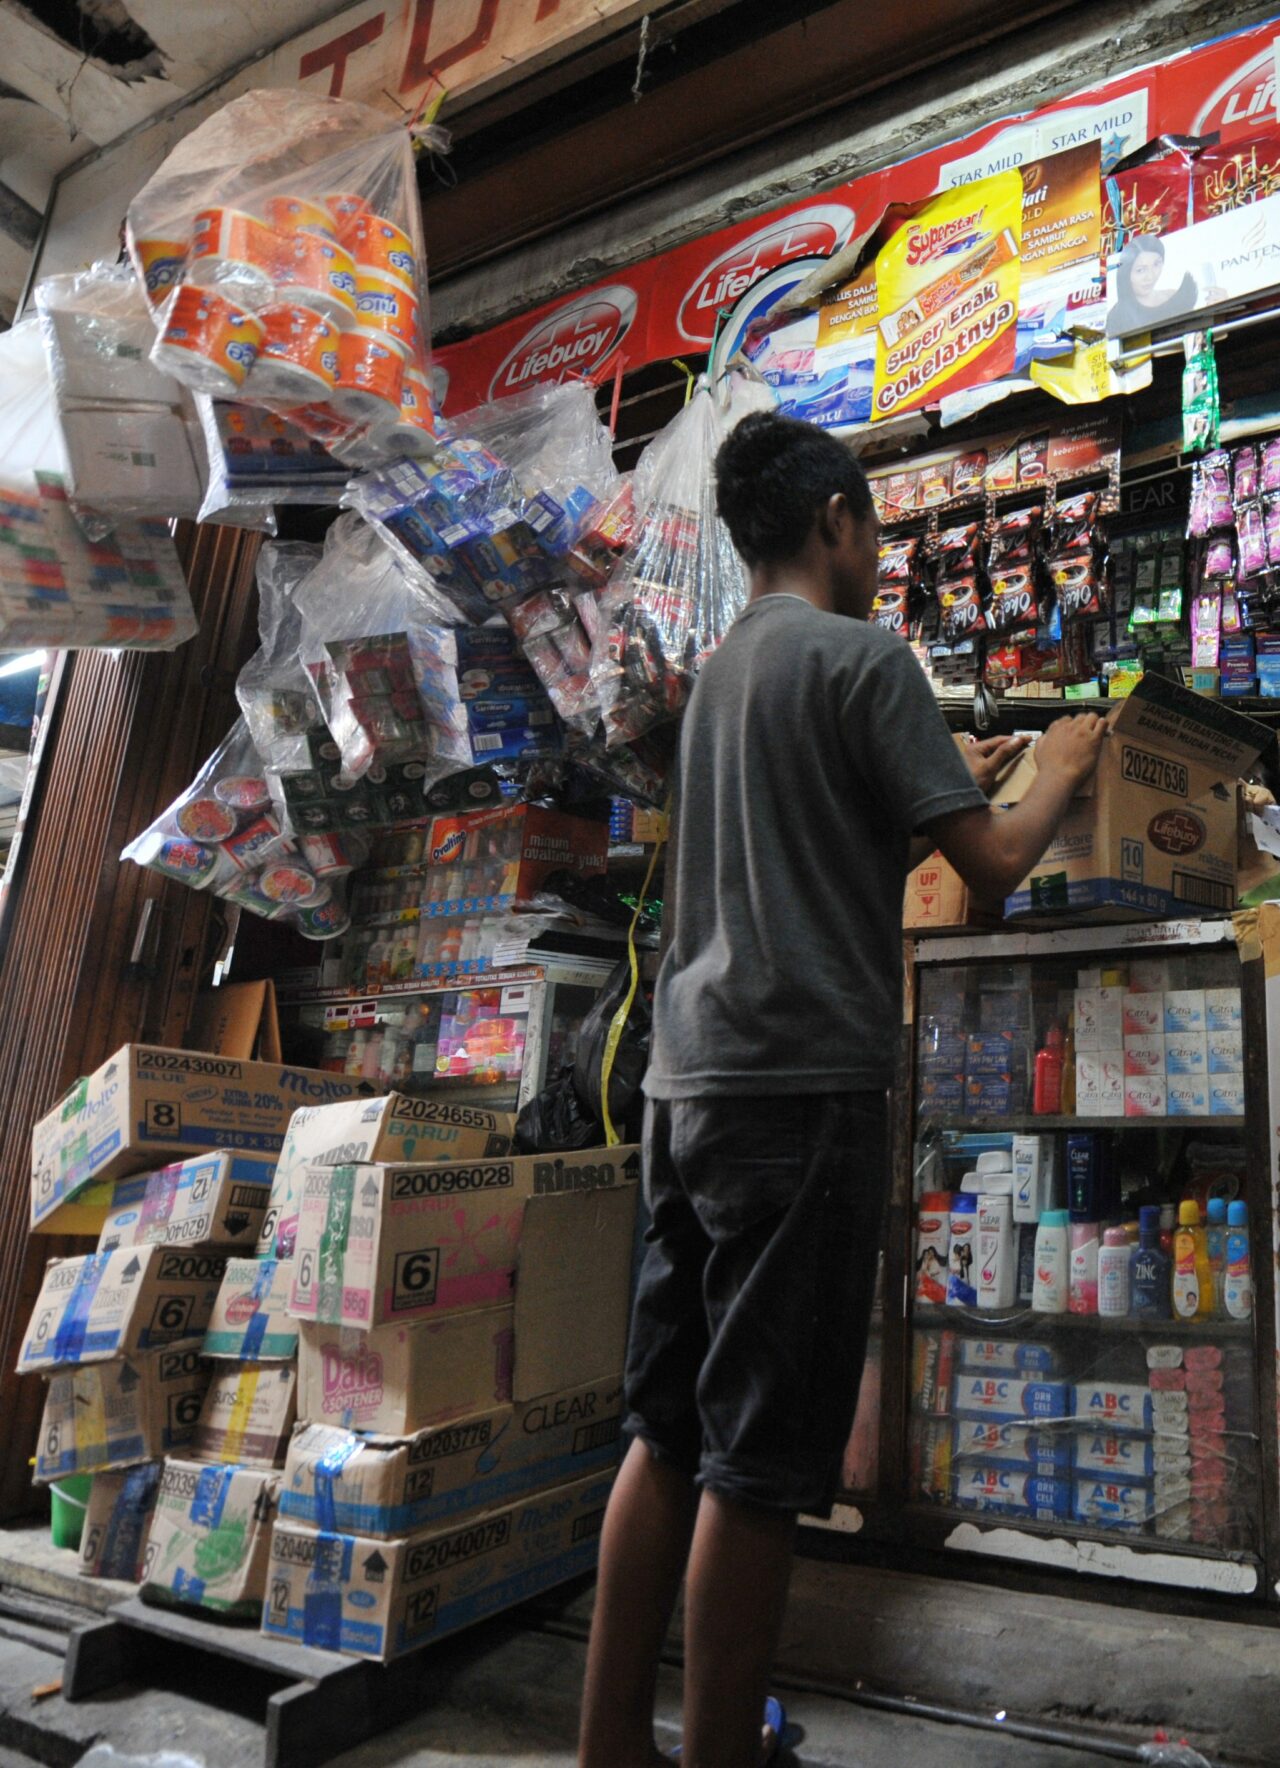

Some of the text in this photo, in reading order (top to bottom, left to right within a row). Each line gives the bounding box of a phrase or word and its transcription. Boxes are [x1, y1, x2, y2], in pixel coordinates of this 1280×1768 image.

[1052, 111, 1132, 150] STAR MILD
[951, 152, 1023, 188] STAR MILD
[1042, 210, 1094, 238] DALAM RASA
[1027, 231, 1067, 250] SAMBUT
[1042, 235, 1088, 258] BANGGA
[830, 310, 863, 325] DENGAN
[887, 283, 998, 373] Super Enak
[505, 327, 609, 386] Lifebuoy
[876, 301, 1015, 411] Cokelatnya
[1125, 750, 1186, 793] 20227636
[433, 831, 467, 861] Ovaltine
[530, 834, 569, 850] minum
[1154, 822, 1200, 846] Lifebuoy
[523, 848, 604, 870] ovaltine yuk!
[1124, 842, 1142, 868] 10
[919, 872, 939, 886] UP
[1126, 1008, 1150, 1019] Citra
[1167, 1005, 1192, 1016] Citra
[1211, 1046, 1236, 1057] Citra
[137, 1071, 187, 1084] BLUE
[139, 1053, 239, 1078] 20243007
[279, 1069, 353, 1098] Molto
[1129, 1090, 1153, 1101] Citra
[1170, 1089, 1195, 1101] Citra
[1213, 1088, 1238, 1099] Citra
[254, 1094, 283, 1111] 20%
[396, 1100, 495, 1129] 20246551
[152, 1103, 176, 1127] 8
[215, 1132, 245, 1146] 216
[388, 1121, 459, 1143] BARU!
[41, 1170, 52, 1194] 8
[394, 1165, 512, 1196] 20096028
[533, 1158, 616, 1194] Rinso
[262, 1209, 275, 1239] 6
[980, 1215, 1002, 1226] CLEAR
[299, 1258, 311, 1289] 6
[402, 1254, 432, 1291] 6
[1136, 1263, 1157, 1281] ZINC
[36, 1312, 50, 1341] 6
[160, 1301, 185, 1328] 6
[975, 1342, 1004, 1355] ABC
[323, 1343, 384, 1394] Daia
[971, 1381, 1009, 1397] ABC
[1034, 1391, 1051, 1400] DRY
[175, 1396, 199, 1425] 6
[522, 1391, 598, 1435] CLEAR
[1034, 1402, 1051, 1411] CELL
[1089, 1392, 1131, 1411] ABC
[47, 1426, 60, 1455] 6
[972, 1426, 1011, 1443] ABC
[1091, 1438, 1133, 1458] ABC
[409, 1471, 432, 1491] 12
[971, 1471, 1011, 1488] ABC
[1092, 1485, 1133, 1503] ABC
[409, 1517, 508, 1575] 62040079
[273, 1582, 289, 1610] 12
[410, 1590, 437, 1622] 12
